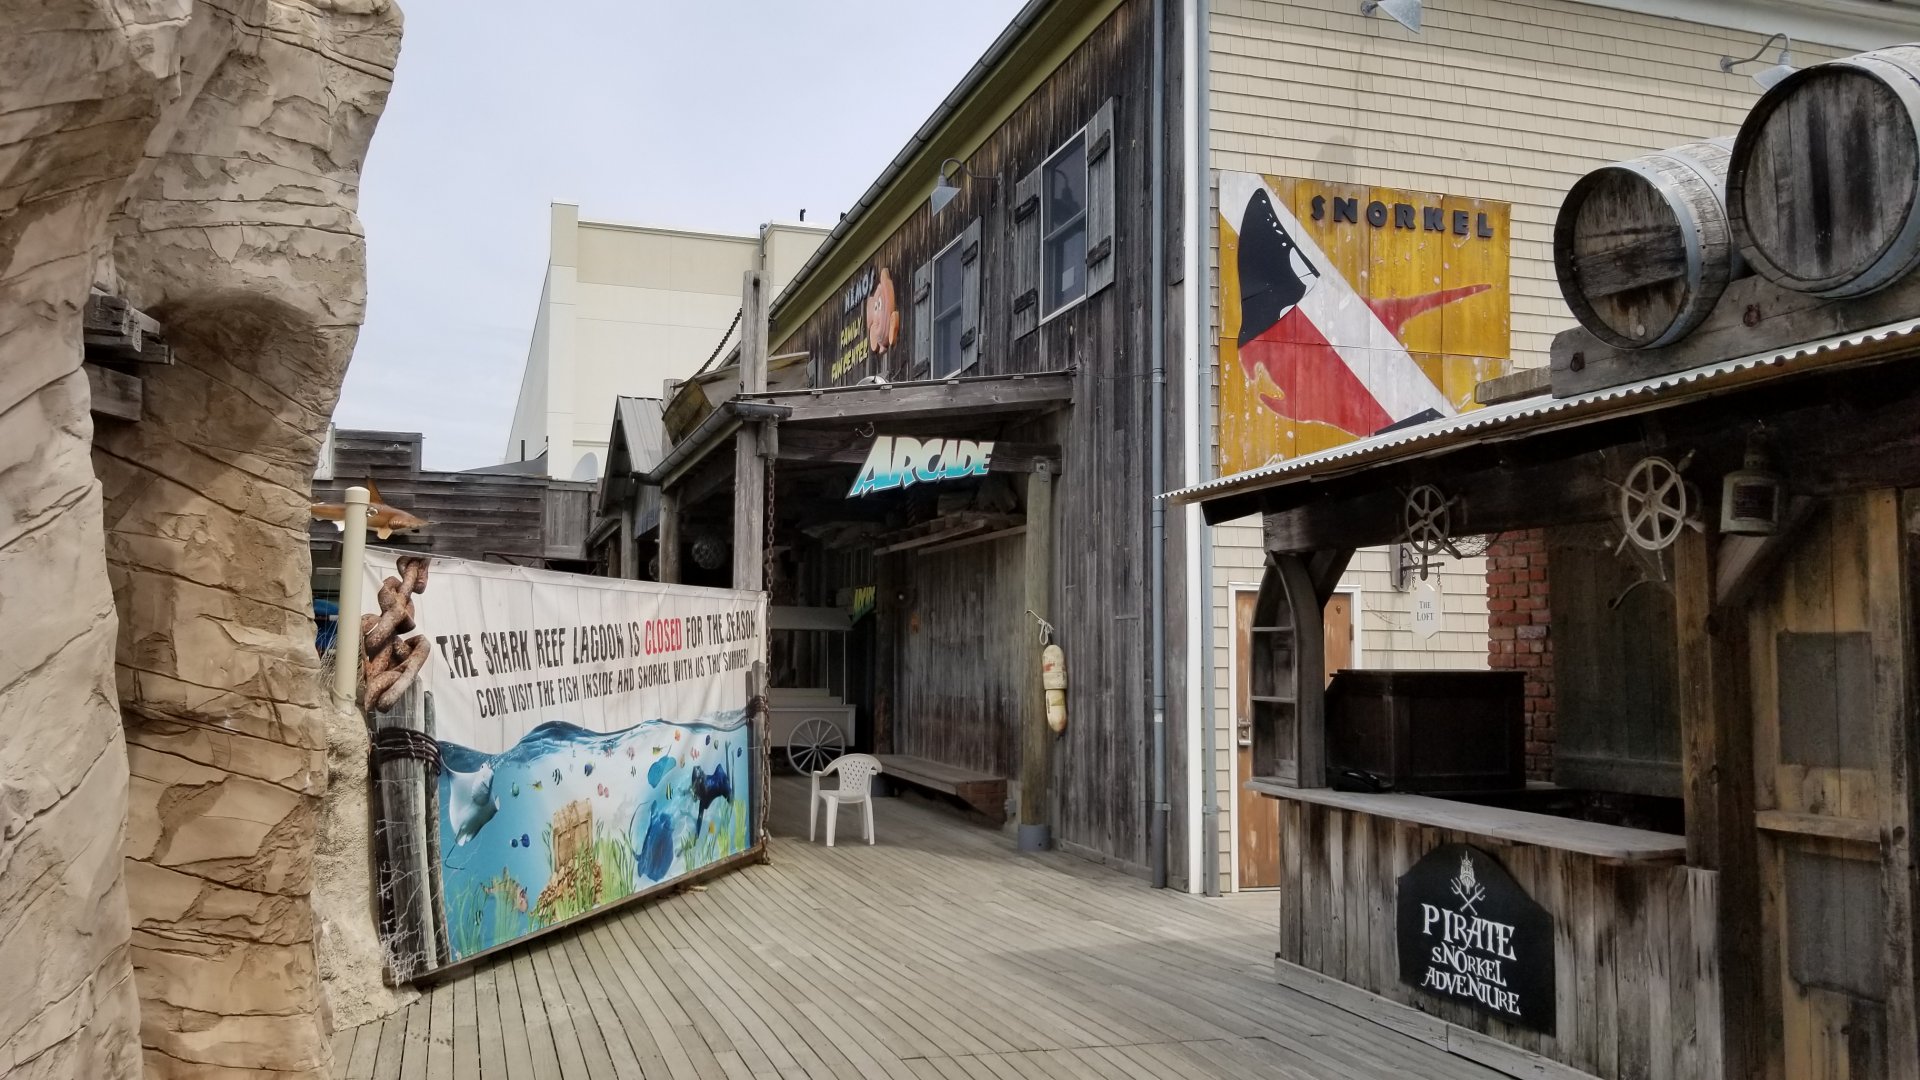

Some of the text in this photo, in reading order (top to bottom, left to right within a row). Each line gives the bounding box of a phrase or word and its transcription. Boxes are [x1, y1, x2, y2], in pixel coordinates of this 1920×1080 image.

[1311, 195, 1494, 238] SNORKEL
[841, 316, 862, 346] FAMILY
[845, 435, 995, 500] ARCADE
[1416, 611, 1434, 621] LOFT
[1419, 600, 1431, 609] THE
[436, 633, 479, 679] THE
[481, 630, 531, 675] SHARK
[534, 627, 566, 669] REEF
[573, 622, 624, 664] LAGOON
[627, 621, 640, 657] IS
[645, 617, 683, 656] CLOSED
[686, 615, 703, 649] FOR
[707, 613, 724, 645] THE
[476, 648, 749, 718] COME VISIT THE FISH INSIDE AND SNORKEL WITH US THIS SUMMER!
[1421, 903, 1517, 961] PIRATE
[1421, 966, 1521, 1015] ADVENTURE
